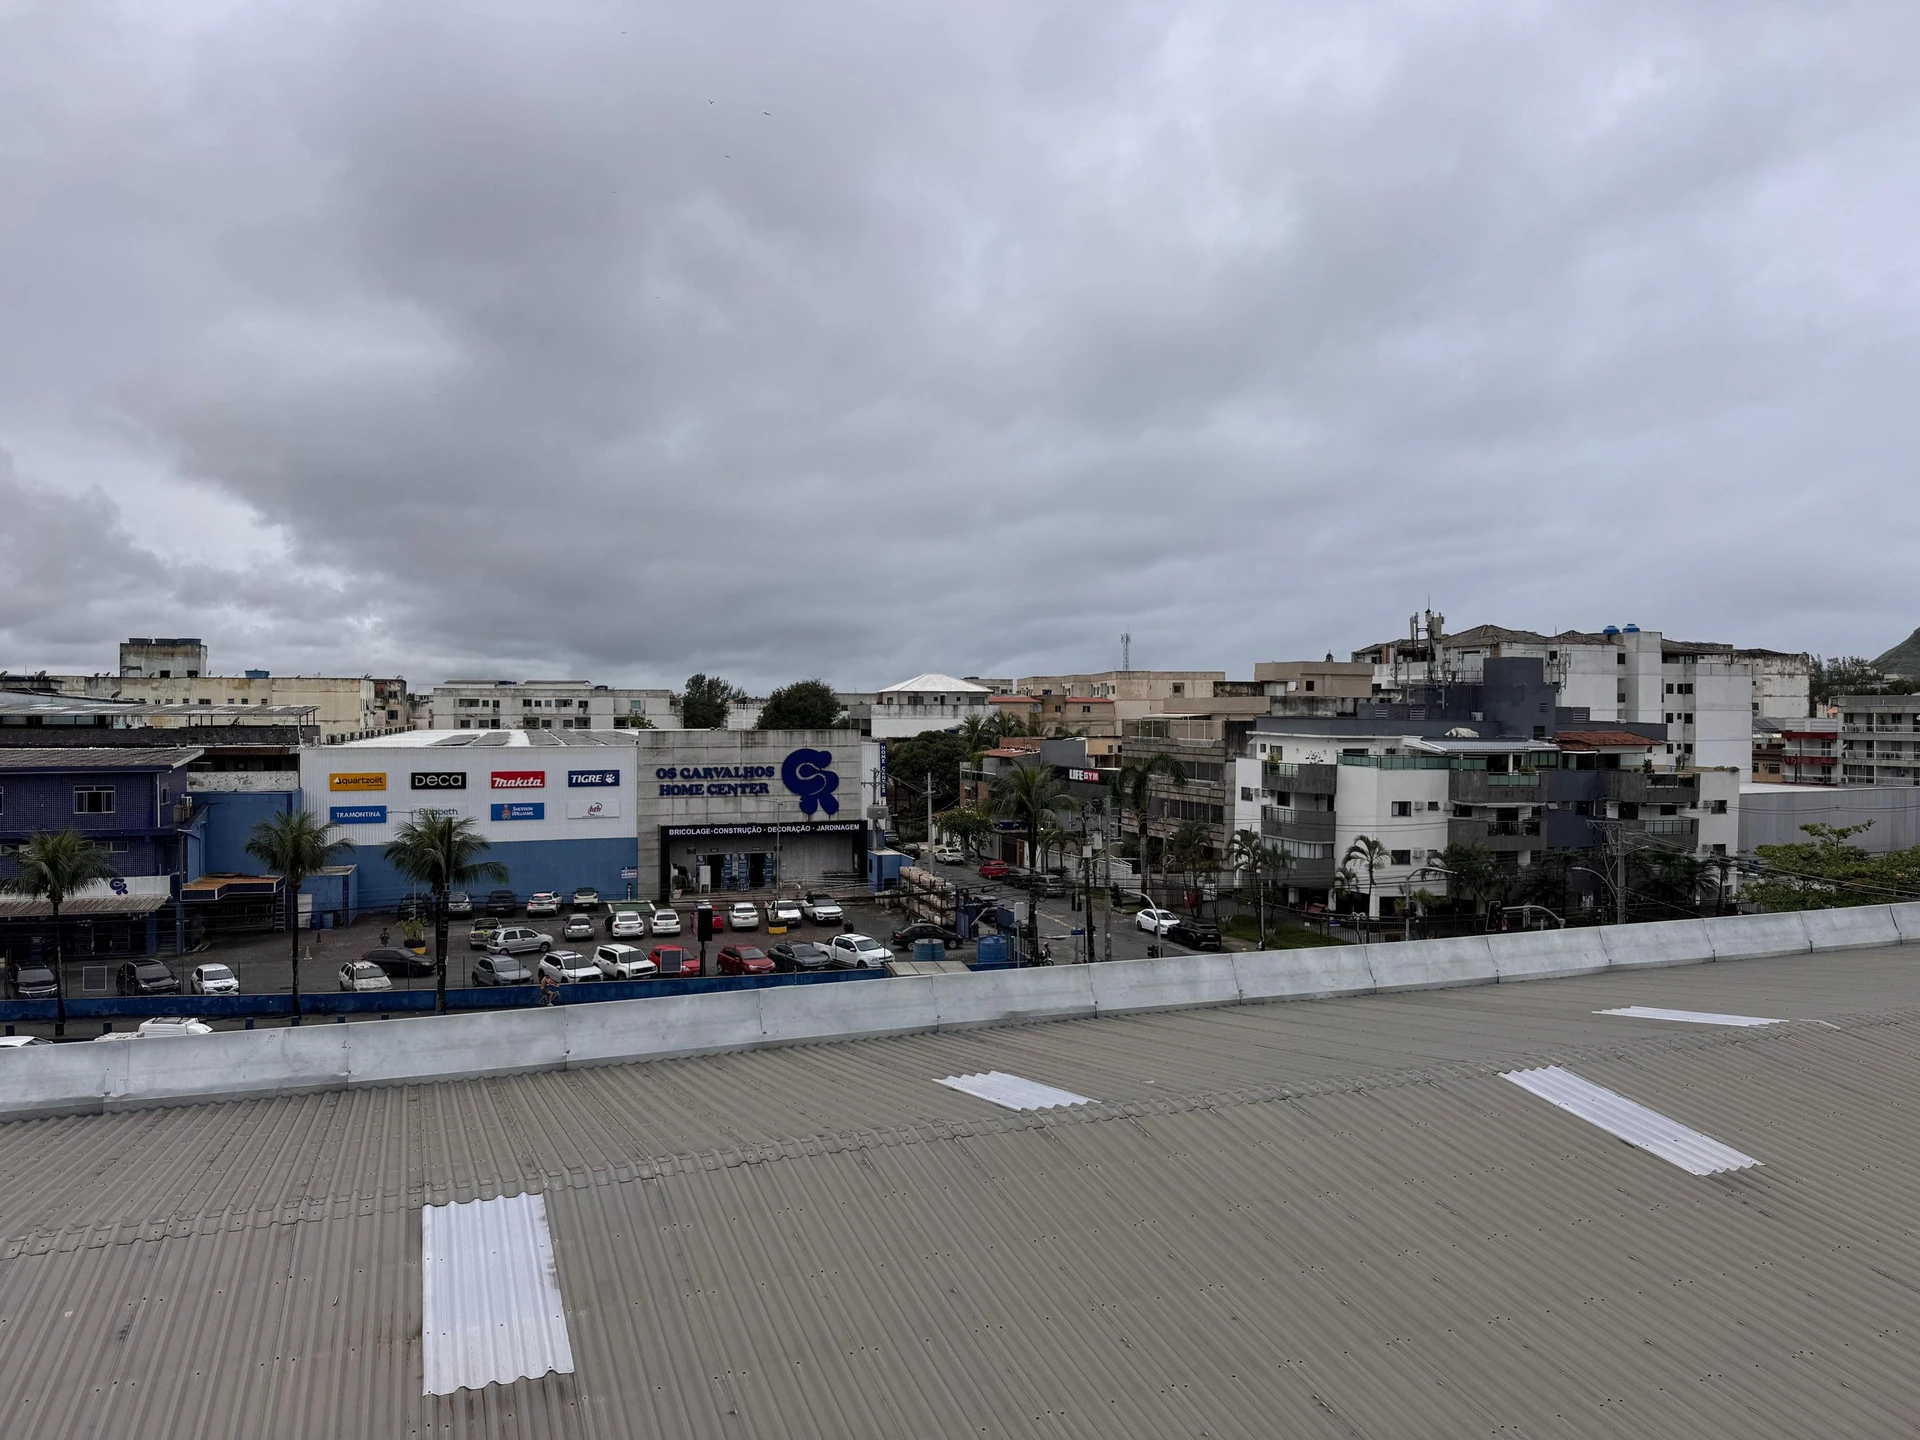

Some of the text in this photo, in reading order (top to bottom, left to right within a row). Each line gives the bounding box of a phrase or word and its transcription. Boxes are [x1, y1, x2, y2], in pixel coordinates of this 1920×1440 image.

[571, 774, 602, 783] TIGRE
[656, 766, 775, 779] OS CARVALHOS
[659, 783, 770, 796] HOME CENTER
[713, 826, 762, 834] CONSTRUÇÃO
[767, 824, 811, 833] DECORAÇÃO
[816, 823, 860, 831] JARDINAGEM
